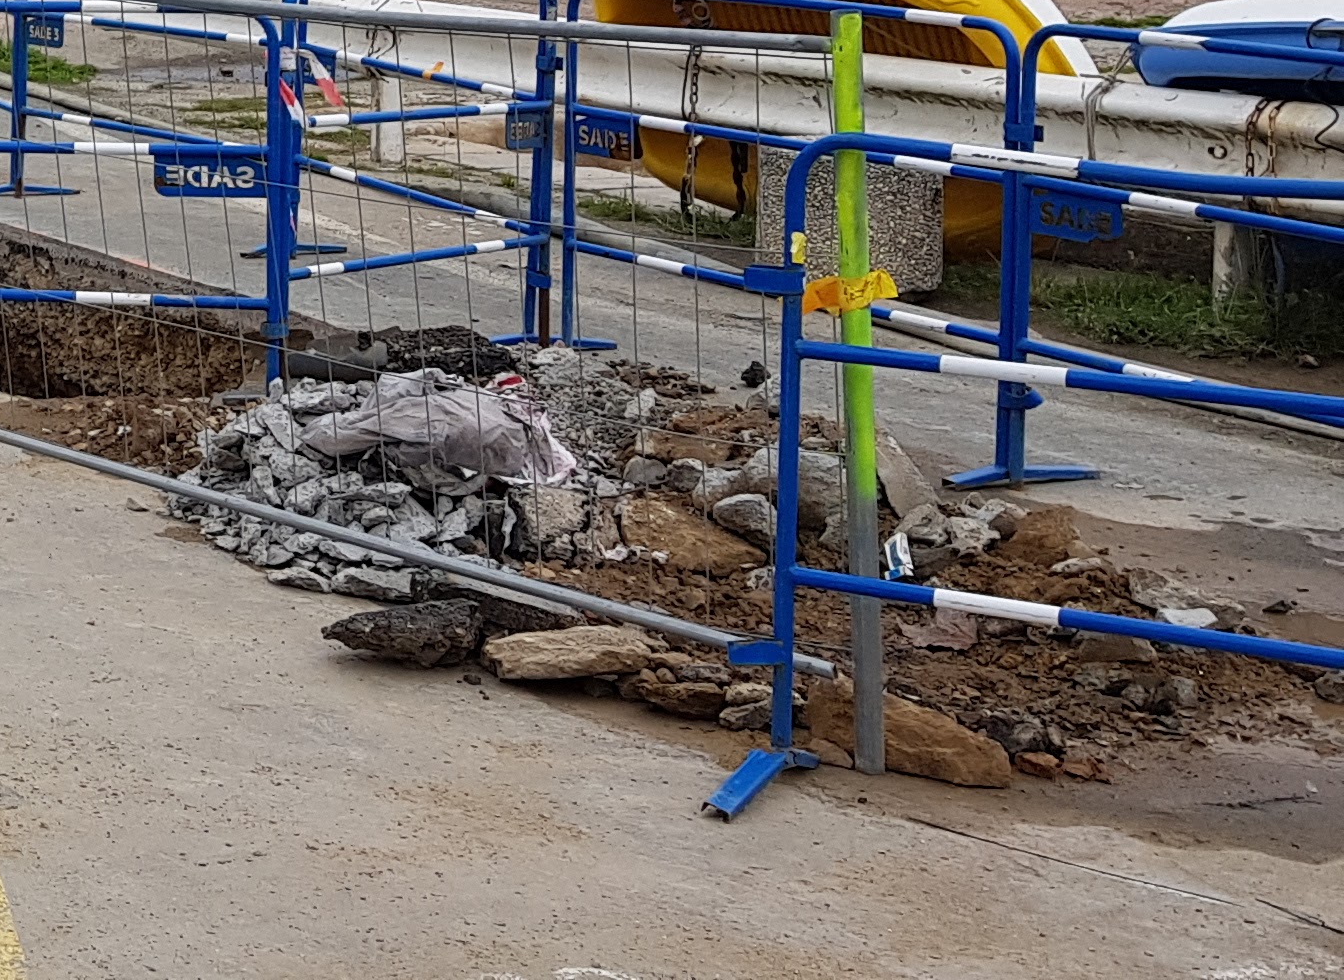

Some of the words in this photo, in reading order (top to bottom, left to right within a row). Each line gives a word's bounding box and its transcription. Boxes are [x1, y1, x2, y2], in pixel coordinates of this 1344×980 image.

[29, 24, 53, 39] SADE
[54, 27, 60, 41] 3
[578, 125, 629, 151] SADE
